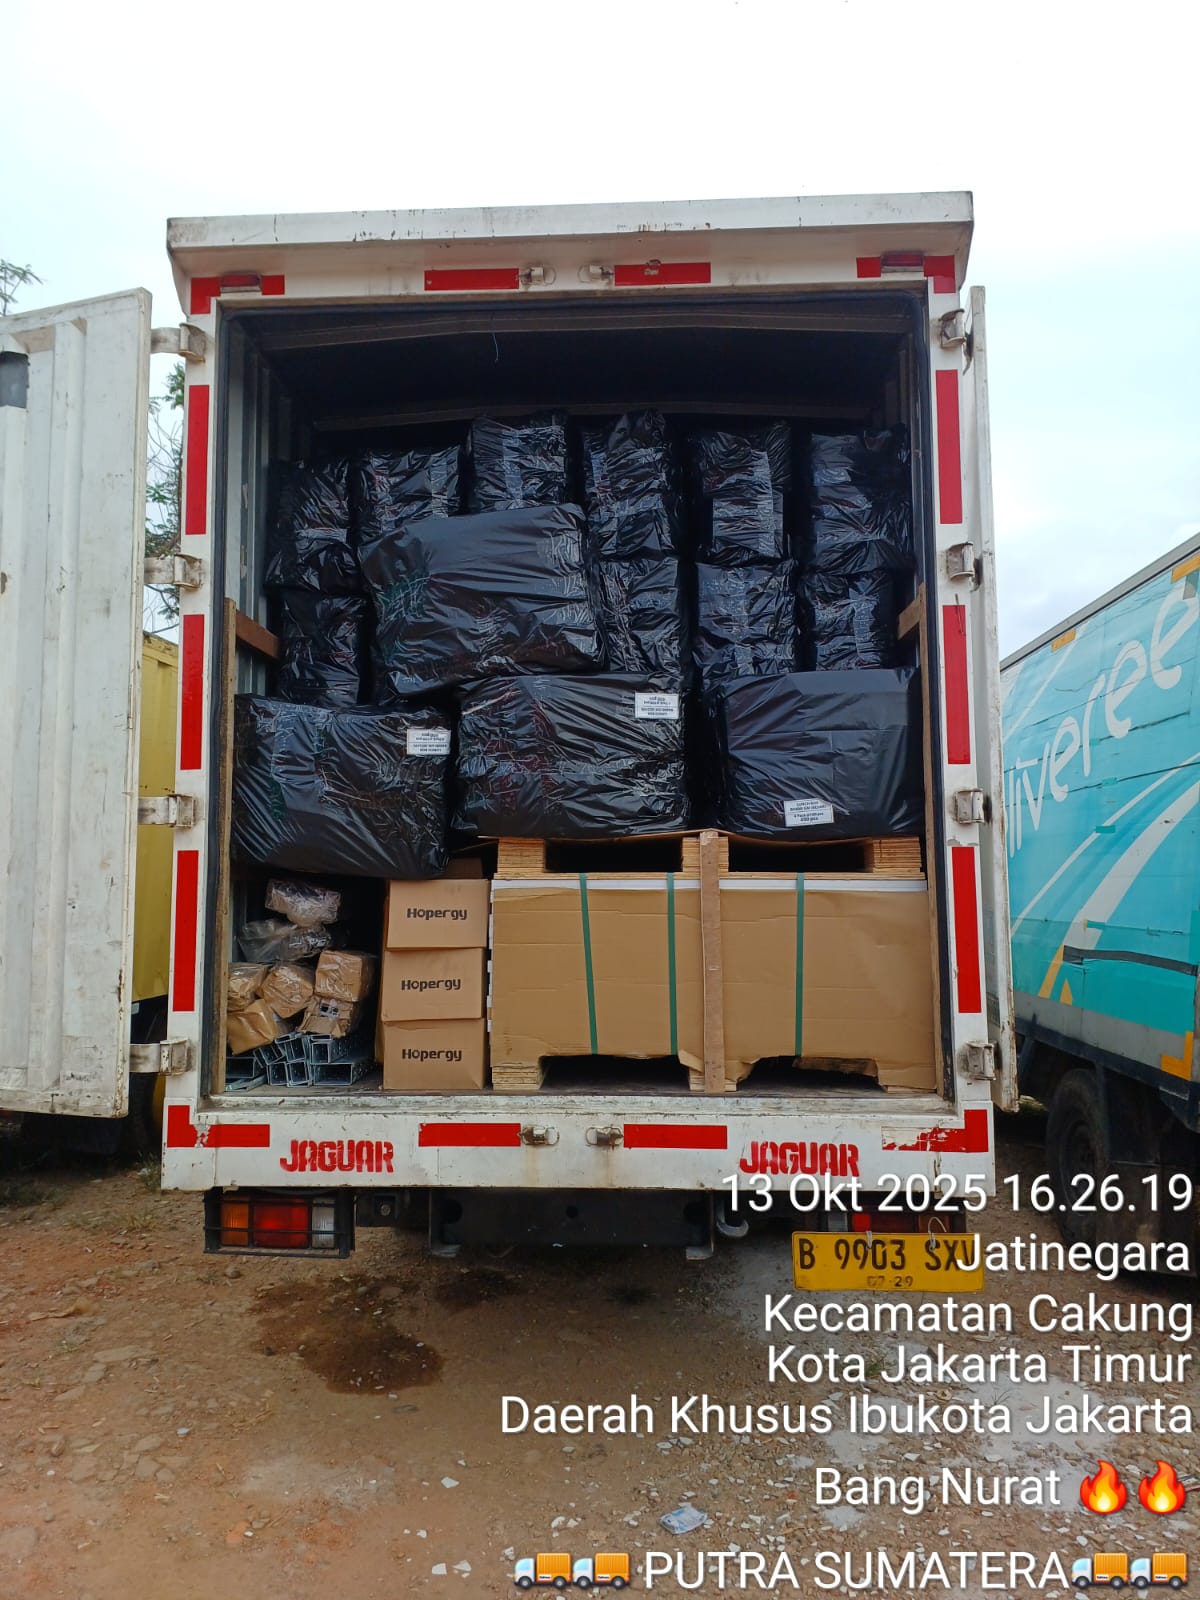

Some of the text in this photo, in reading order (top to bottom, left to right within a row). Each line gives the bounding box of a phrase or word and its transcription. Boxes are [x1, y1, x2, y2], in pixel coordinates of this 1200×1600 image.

[1004, 582, 1200, 858] liveree
[406, 908, 468, 921] Hopergy
[401, 978, 462, 992] Hopergy
[402, 1048, 462, 1062] Hopergy
[280, 1139, 394, 1173] JAGUAR
[740, 1141, 860, 1177] JAGUAR
[799, 1238, 816, 1270] B
[834, 1237, 906, 1271] 9903
